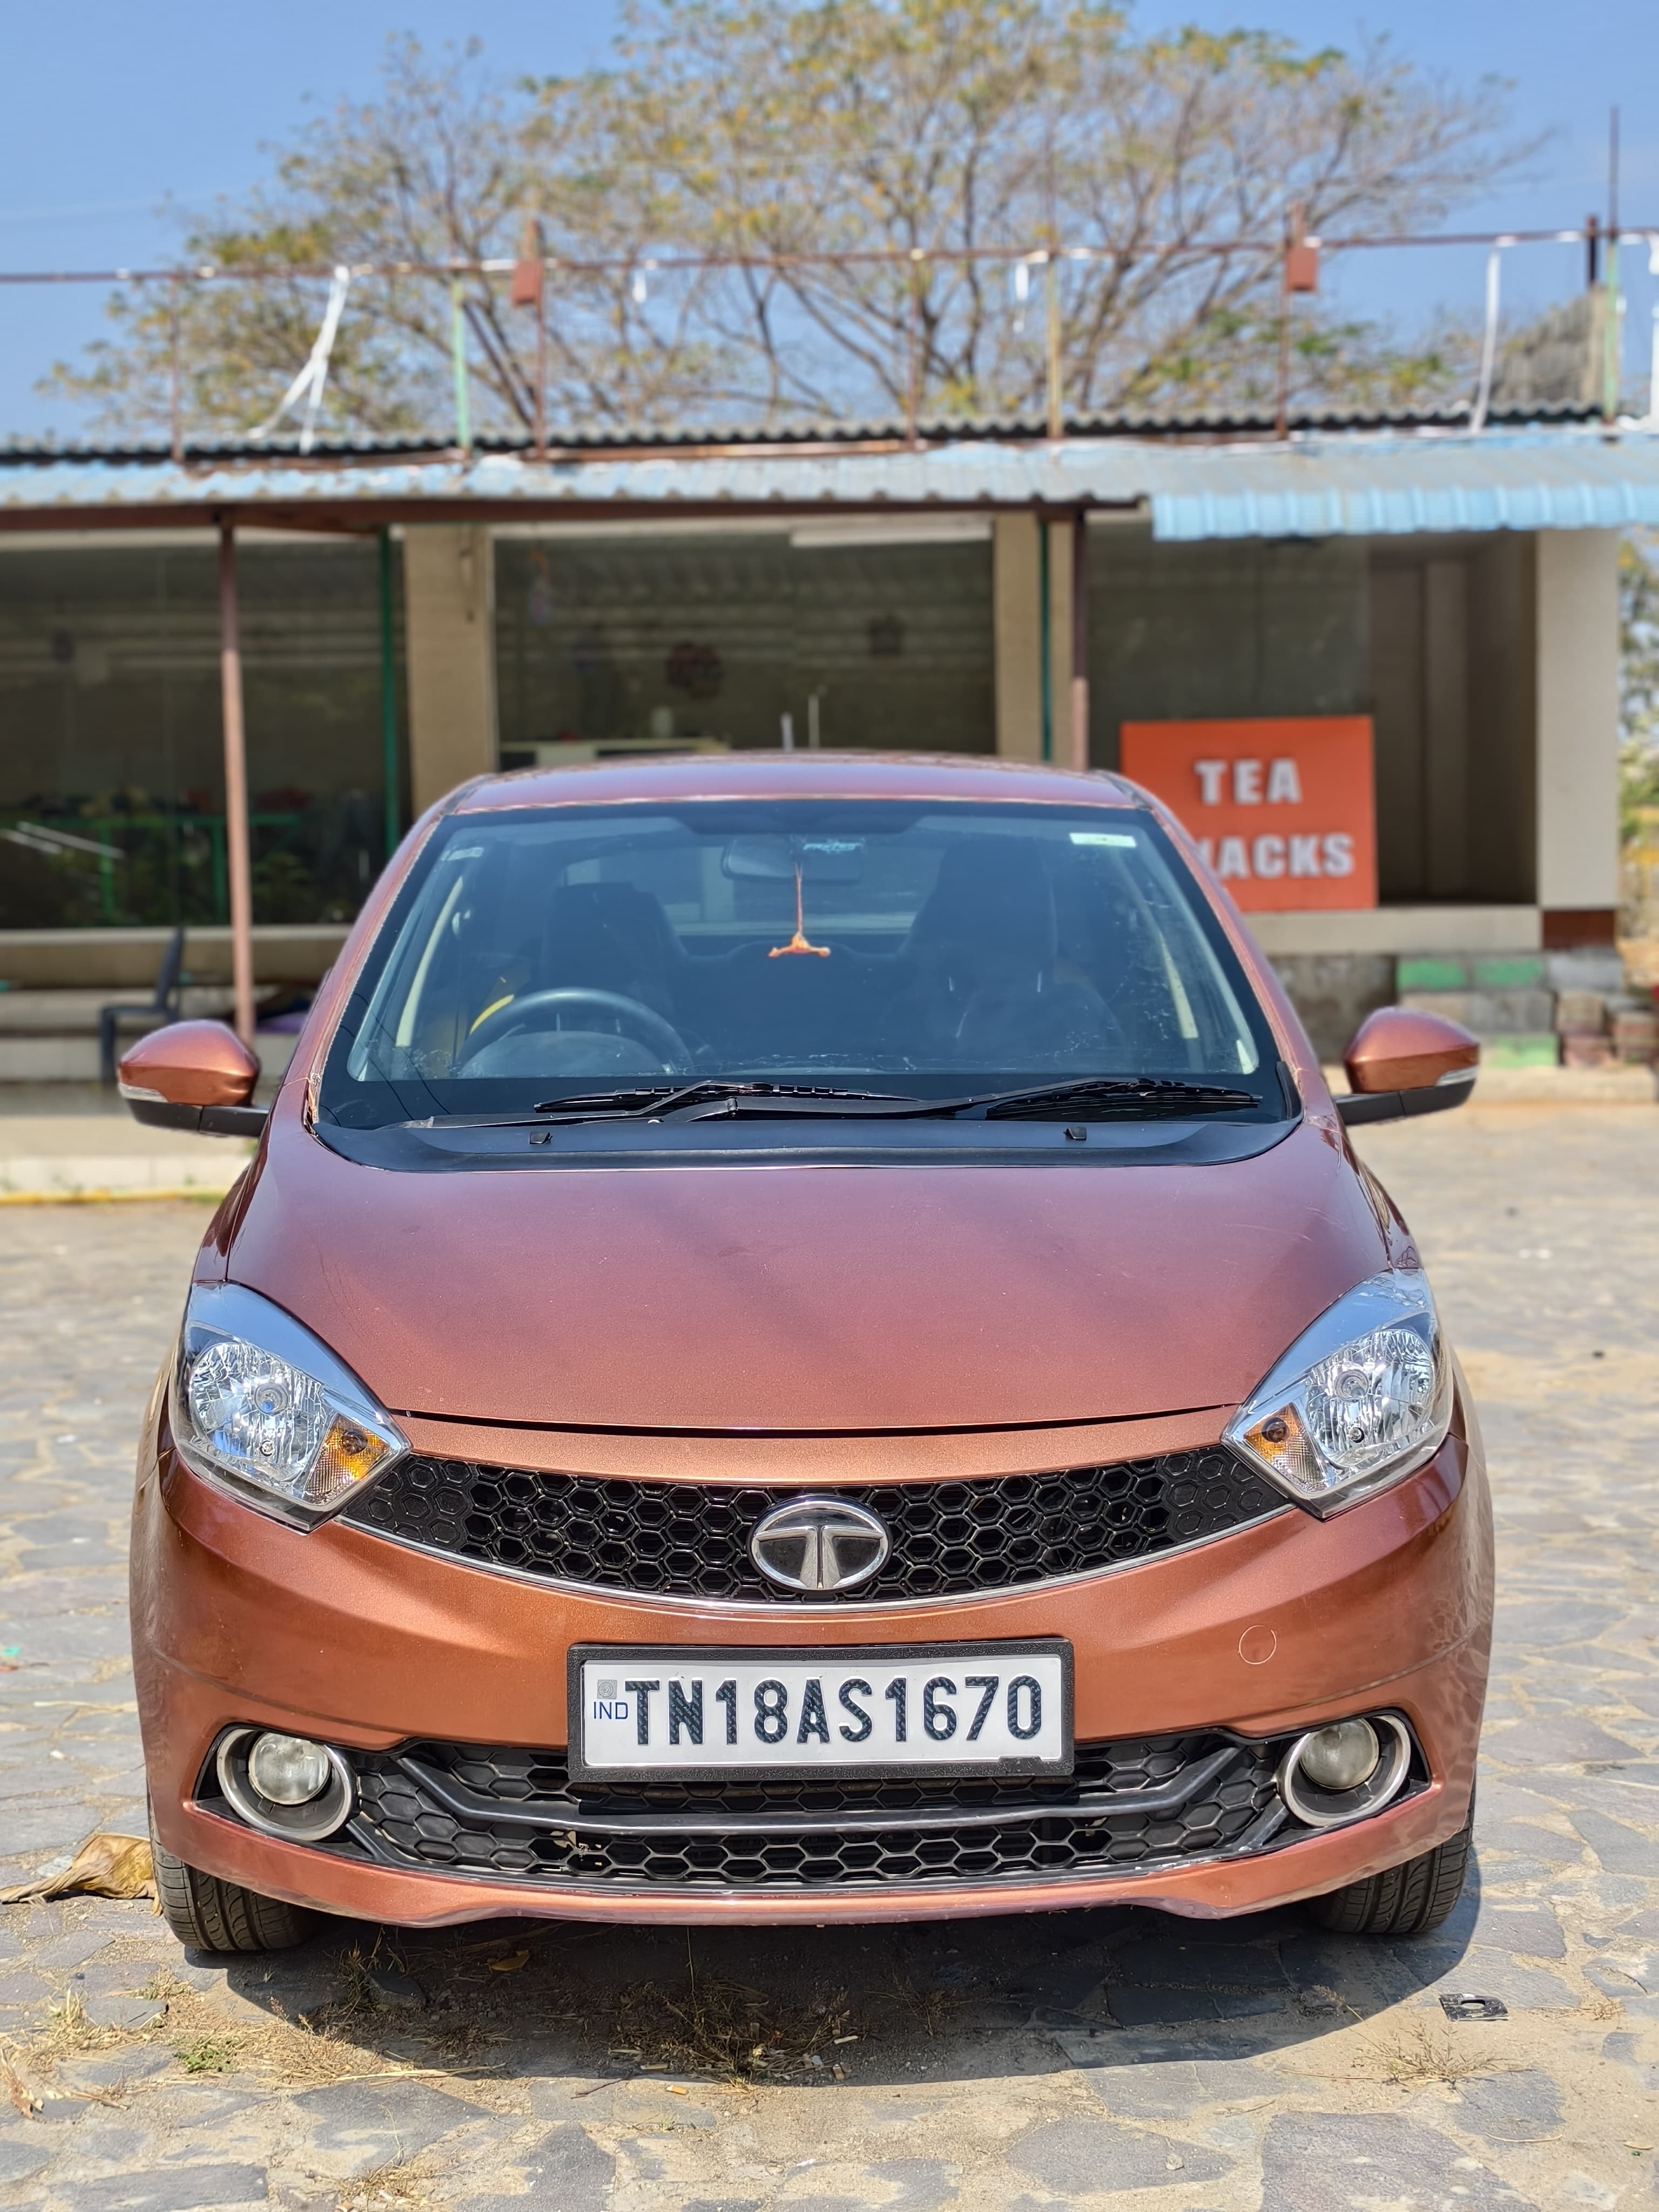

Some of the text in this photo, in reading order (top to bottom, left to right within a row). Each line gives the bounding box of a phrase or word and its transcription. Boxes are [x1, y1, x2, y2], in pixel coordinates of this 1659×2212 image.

[1194, 759, 1302, 805] TEA
[594, 1701, 629, 1719] IND
[625, 1675, 1042, 1745] TN18AS1670
